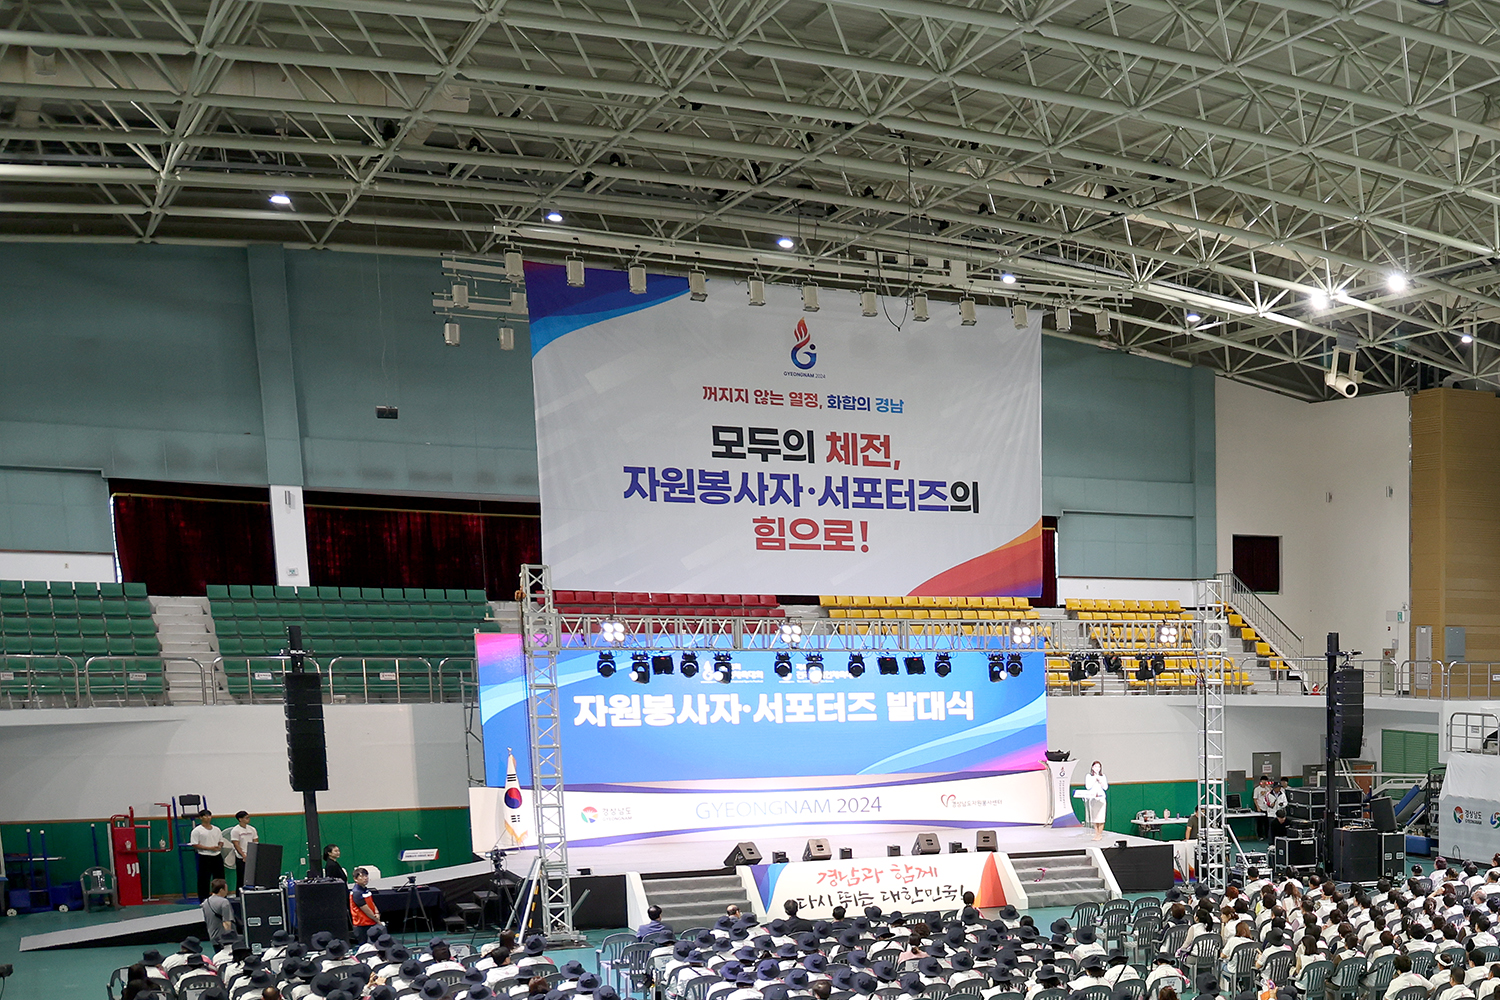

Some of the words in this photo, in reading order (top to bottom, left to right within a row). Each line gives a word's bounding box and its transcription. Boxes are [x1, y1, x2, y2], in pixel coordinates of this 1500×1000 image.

[702, 386, 749, 403] 꺼지지
[754, 389, 784, 406] 않는
[788, 391, 823, 410] 열정,
[827, 394, 871, 412] 화합의
[876, 397, 904, 414] 경남
[712, 425, 815, 464] 모두의
[825, 430, 901, 470] 체전,
[623, 466, 980, 513] 자원봉사자·서포터즈의
[752, 516, 869, 553] 힘으로!
[886, 690, 974, 723] 발대식
[696, 799, 831, 820] GYEONGNAM
[837, 796, 882, 814] 2024
[817, 867, 883, 887] 경남과
[890, 863, 938, 884] 함께
[838, 889, 874, 909] 뛰는
